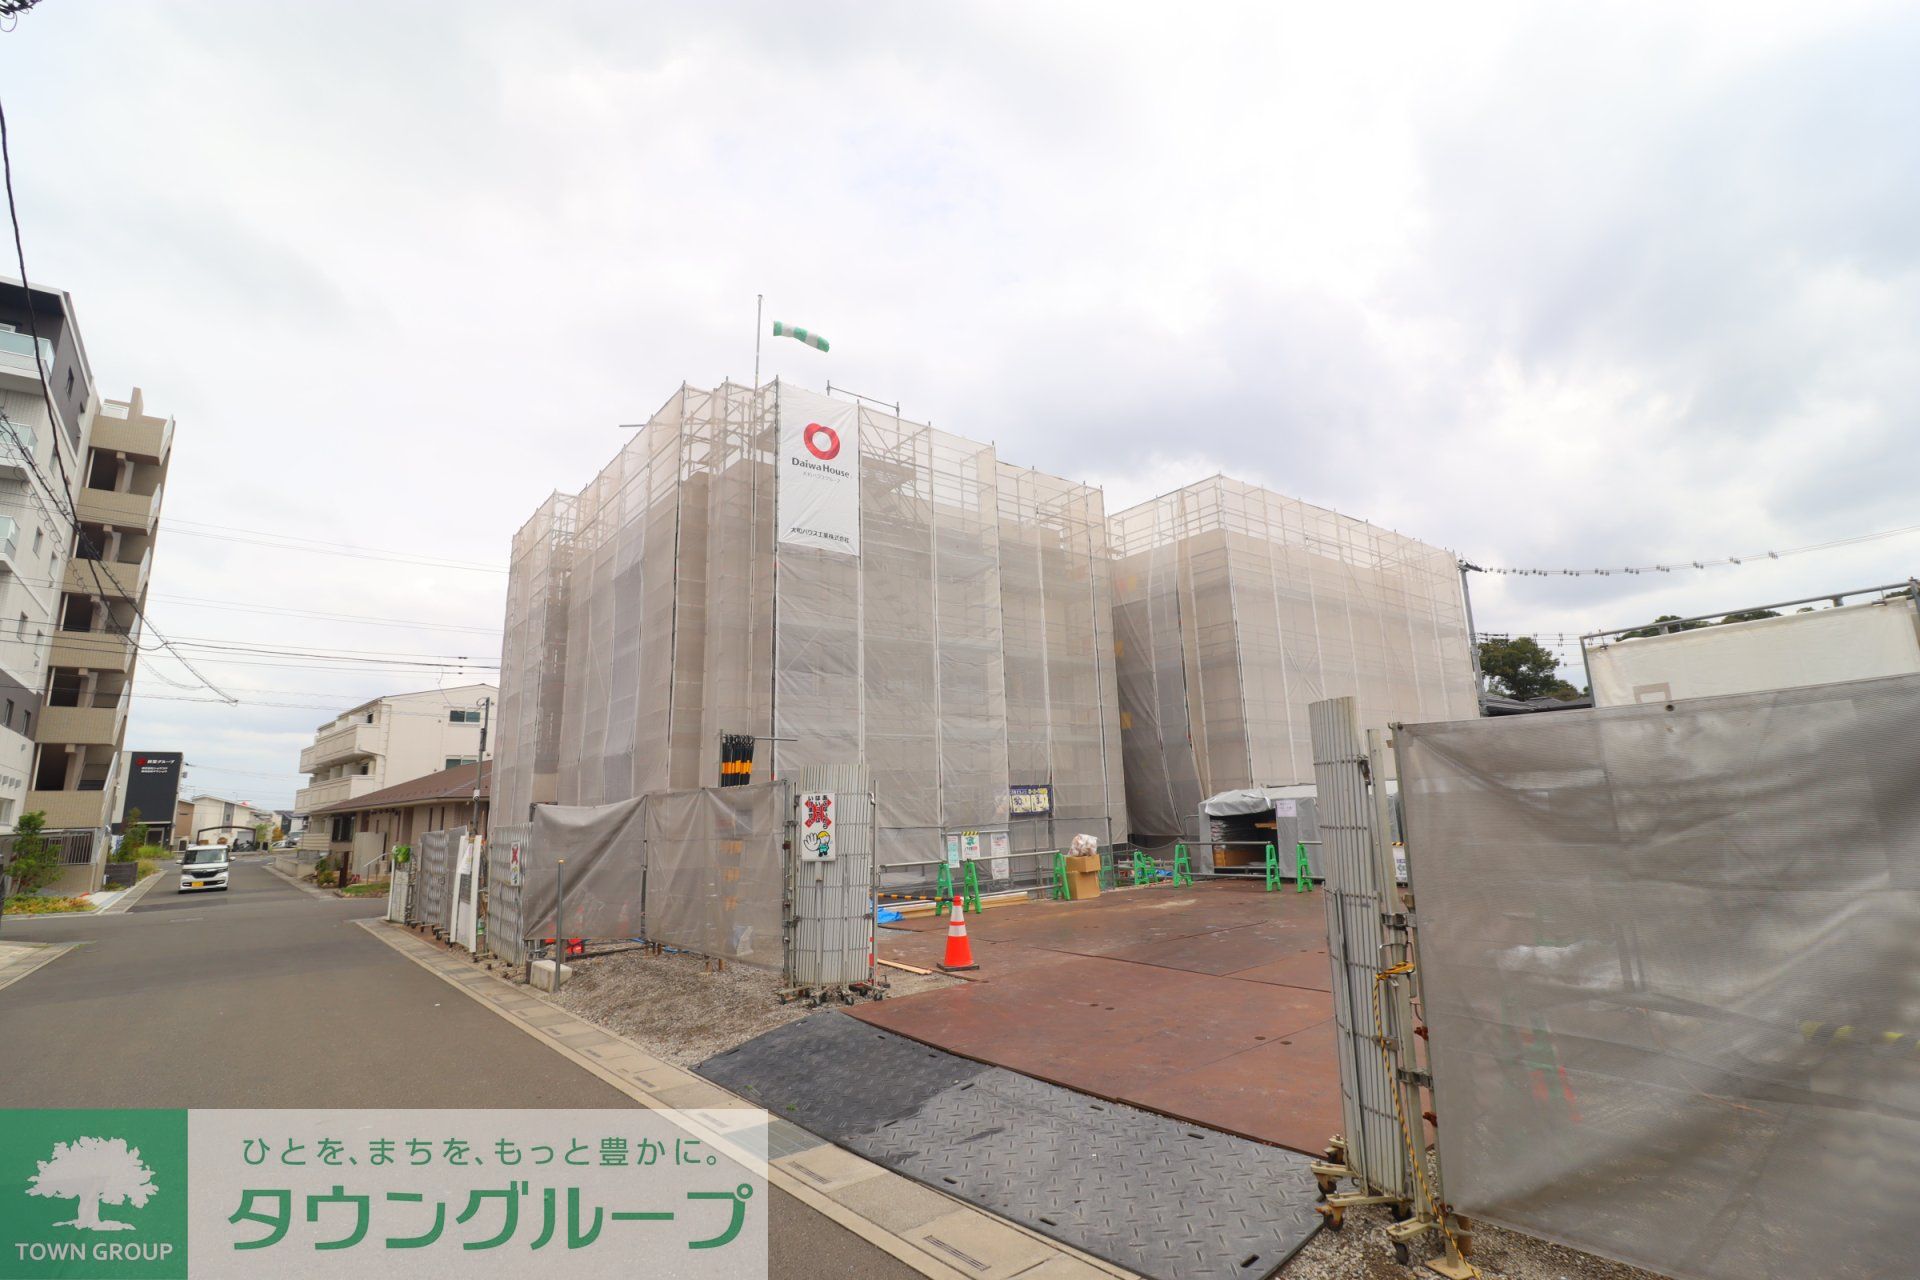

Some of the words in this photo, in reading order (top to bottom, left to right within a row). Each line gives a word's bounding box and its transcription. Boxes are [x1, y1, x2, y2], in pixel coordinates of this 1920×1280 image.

[791, 457, 822, 472] Daiwa
[823, 464, 850, 479] House
[791, 527, 850, 544] 大和ハウス工業株式会社
